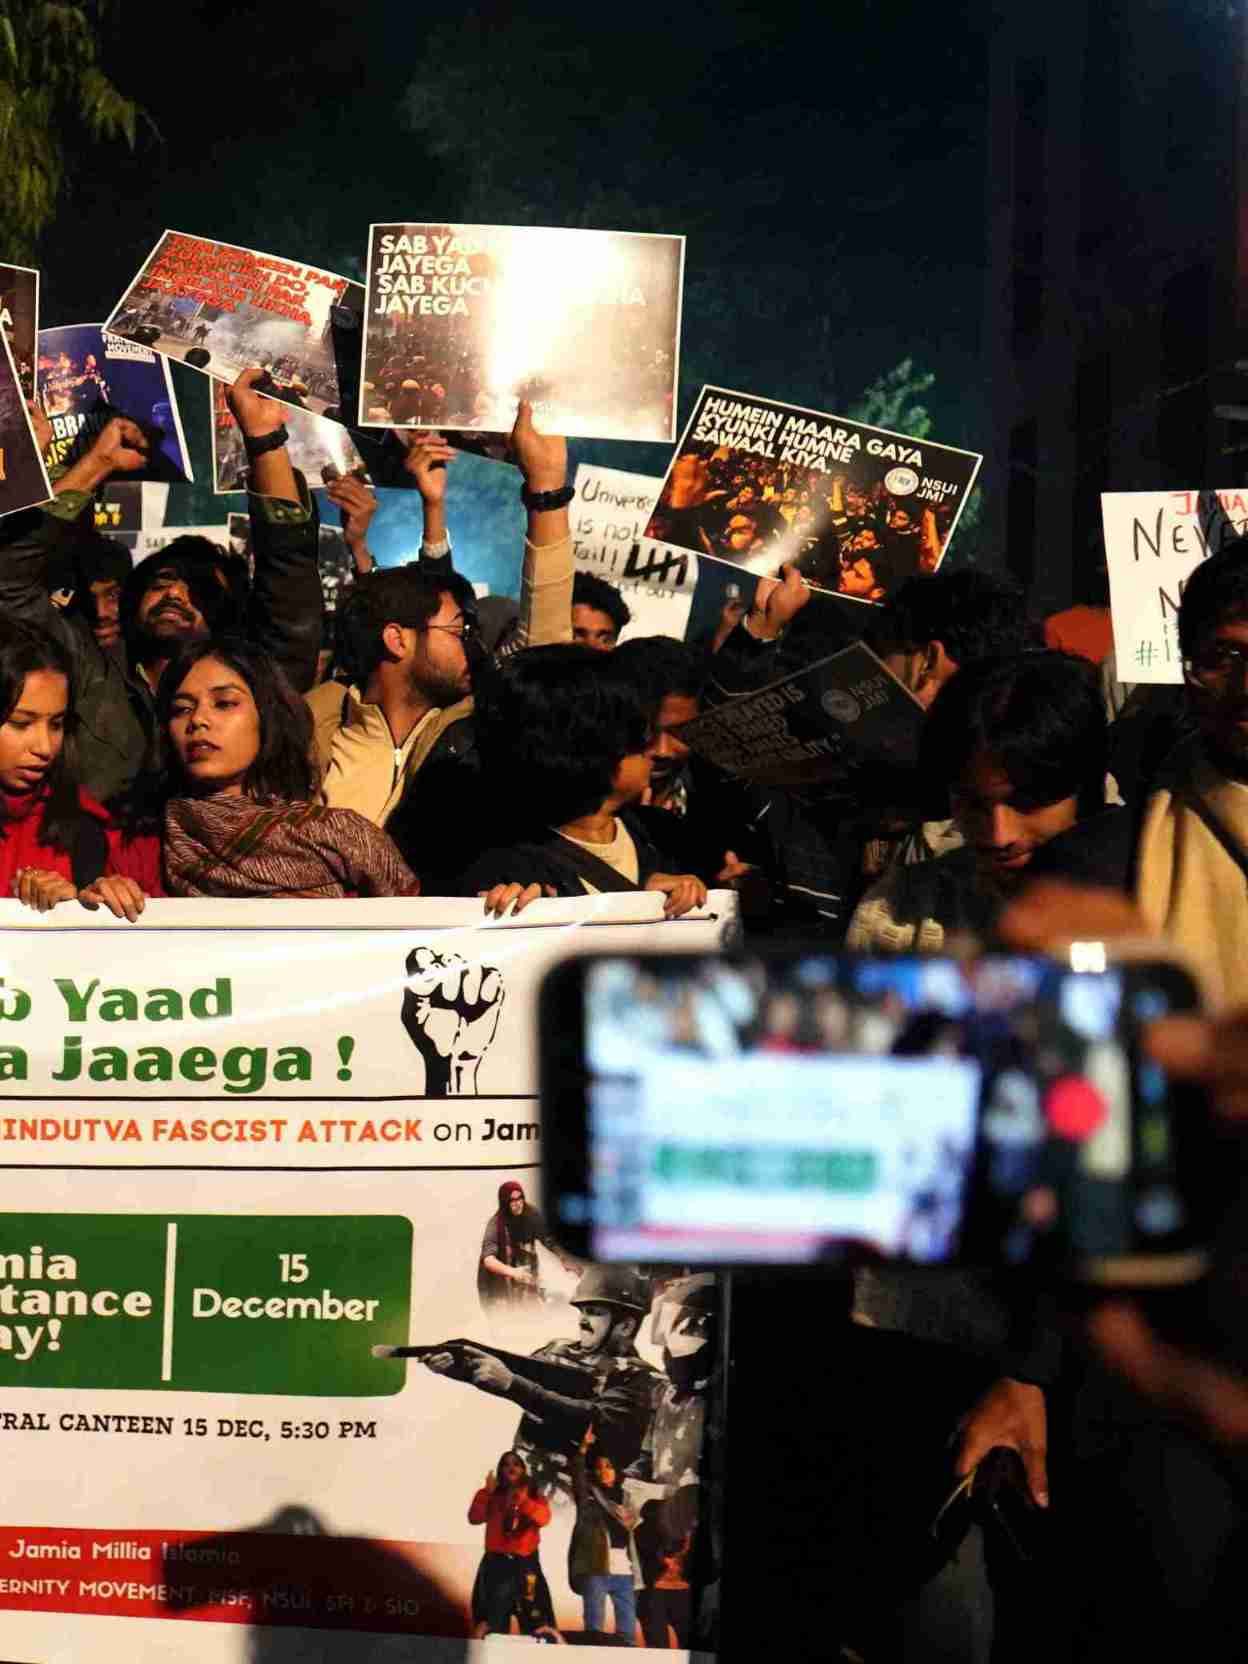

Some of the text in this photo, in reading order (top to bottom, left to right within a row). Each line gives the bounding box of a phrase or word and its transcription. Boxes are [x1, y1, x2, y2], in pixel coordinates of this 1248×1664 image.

[379, 234, 428, 255] SAB
[374, 254, 472, 275] JAYEGA
[377, 275, 427, 295] SAB
[374, 295, 470, 316] JAYEGA
[697, 411, 854, 464] KYUNKI HUMNE
[703, 397, 923, 468] HUMEIN MAARA GAYA
[692, 426, 832, 475] SAWAAL KIYA.
[916, 488, 945, 503] JMI
[920, 476, 958, 496] NSUI
[53, 976, 233, 1023] Yaad
[336, 1034, 356, 1082] !
[152, 1118, 288, 1142] FASCIST
[297, 1118, 423, 1143] ATTACK
[433, 1122, 473, 1142] on
[480, 1117, 542, 1142] Jam
[278, 1253, 310, 1284] 15
[191, 1288, 381, 1322] December
[58, 1412, 174, 1435] CANTEEN
[182, 1417, 209, 1437] 15
[216, 1418, 271, 1442] DEC,
[279, 1420, 331, 1440] 5:30
[337, 1420, 377, 1439] PM
[8, 1539, 81, 1560] Jamia
[91, 1539, 152, 1561] Millia
